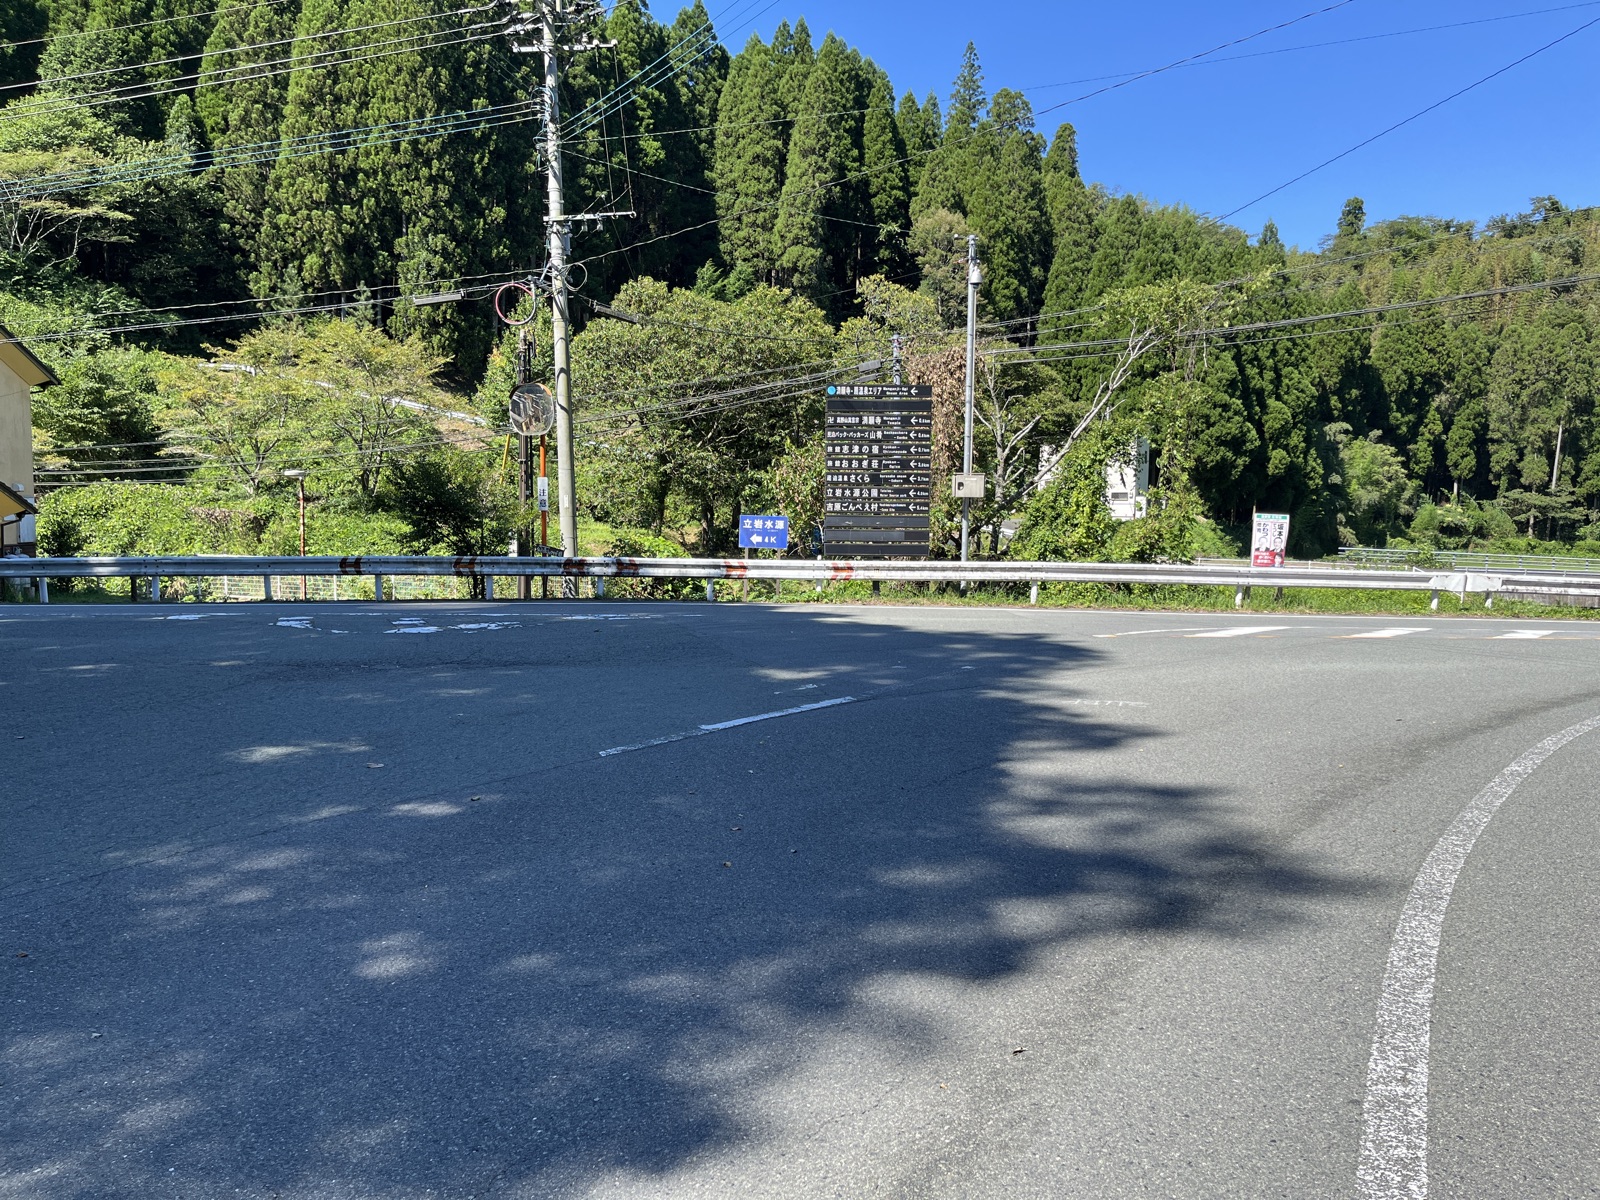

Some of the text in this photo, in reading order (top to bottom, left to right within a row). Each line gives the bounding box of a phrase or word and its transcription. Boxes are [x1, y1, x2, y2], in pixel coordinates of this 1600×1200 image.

[539, 488, 547, 508] 注意
[826, 488, 878, 498] 立岩水源公園
[742, 518, 785, 529] 立岩水源
